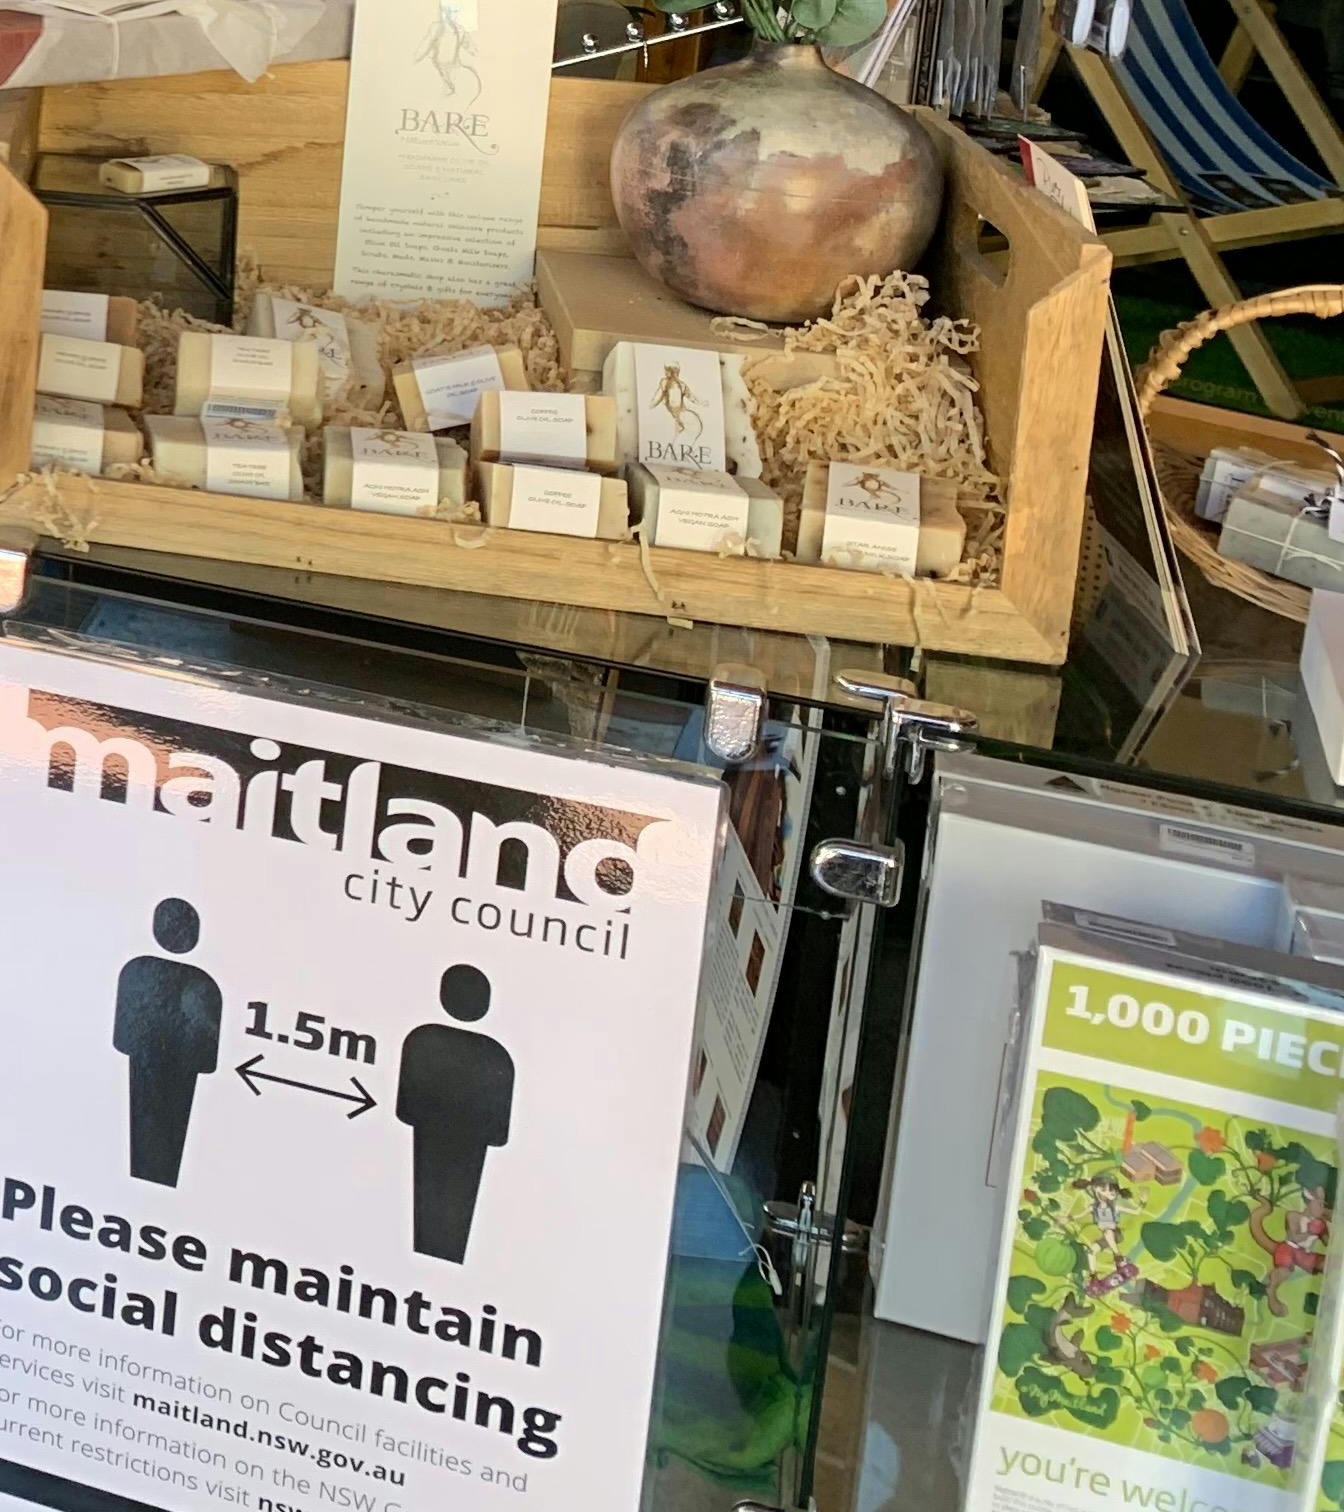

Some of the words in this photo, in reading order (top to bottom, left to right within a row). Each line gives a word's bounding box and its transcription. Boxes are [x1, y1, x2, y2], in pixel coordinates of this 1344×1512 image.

[395, 108, 495, 144] BARE
[389, 207, 424, 216] yourself
[427, 209, 446, 217] with
[486, 225, 524, 235] products
[378, 280, 387, 288] of
[460, 288, 473, 296] for
[447, 276, 467, 284] also
[469, 277, 483, 285] has
[644, 440, 713, 470] BARE
[706, 520, 730, 528] SOAP
[22, 688, 676, 915] maitland
[343, 866, 434, 923] city
[451, 893, 633, 961] council
[243, 999, 378, 1066] 1.5m
[1063, 984, 1211, 1045] 1,000
[1220, 1019, 1344, 1077] PIEC
[1, 1176, 208, 1272] Please
[228, 1242, 544, 1369] maintain
[32, 1335, 92, 1362] more
[98, 1348, 233, 1404] information
[241, 1392, 270, 1416] on
[278, 1396, 366, 1443] Council
[374, 1428, 473, 1477] facilities
[480, 1461, 529, 1493] and
[198, 1305, 564, 1460] distancing
[27, 1396, 86, 1426] more
[94, 1414, 227, 1469] information
[234, 1457, 264, 1480] on
[273, 1466, 310, 1495] the
[71, 1431, 199, 1491] restrictions
[205, 1480, 250, 1507] visit
[82, 1375, 126, 1403] visit
[133, 1392, 406, 1497] maitland.nsw.gov.au
[995, 1444, 1111, 1497] you're
